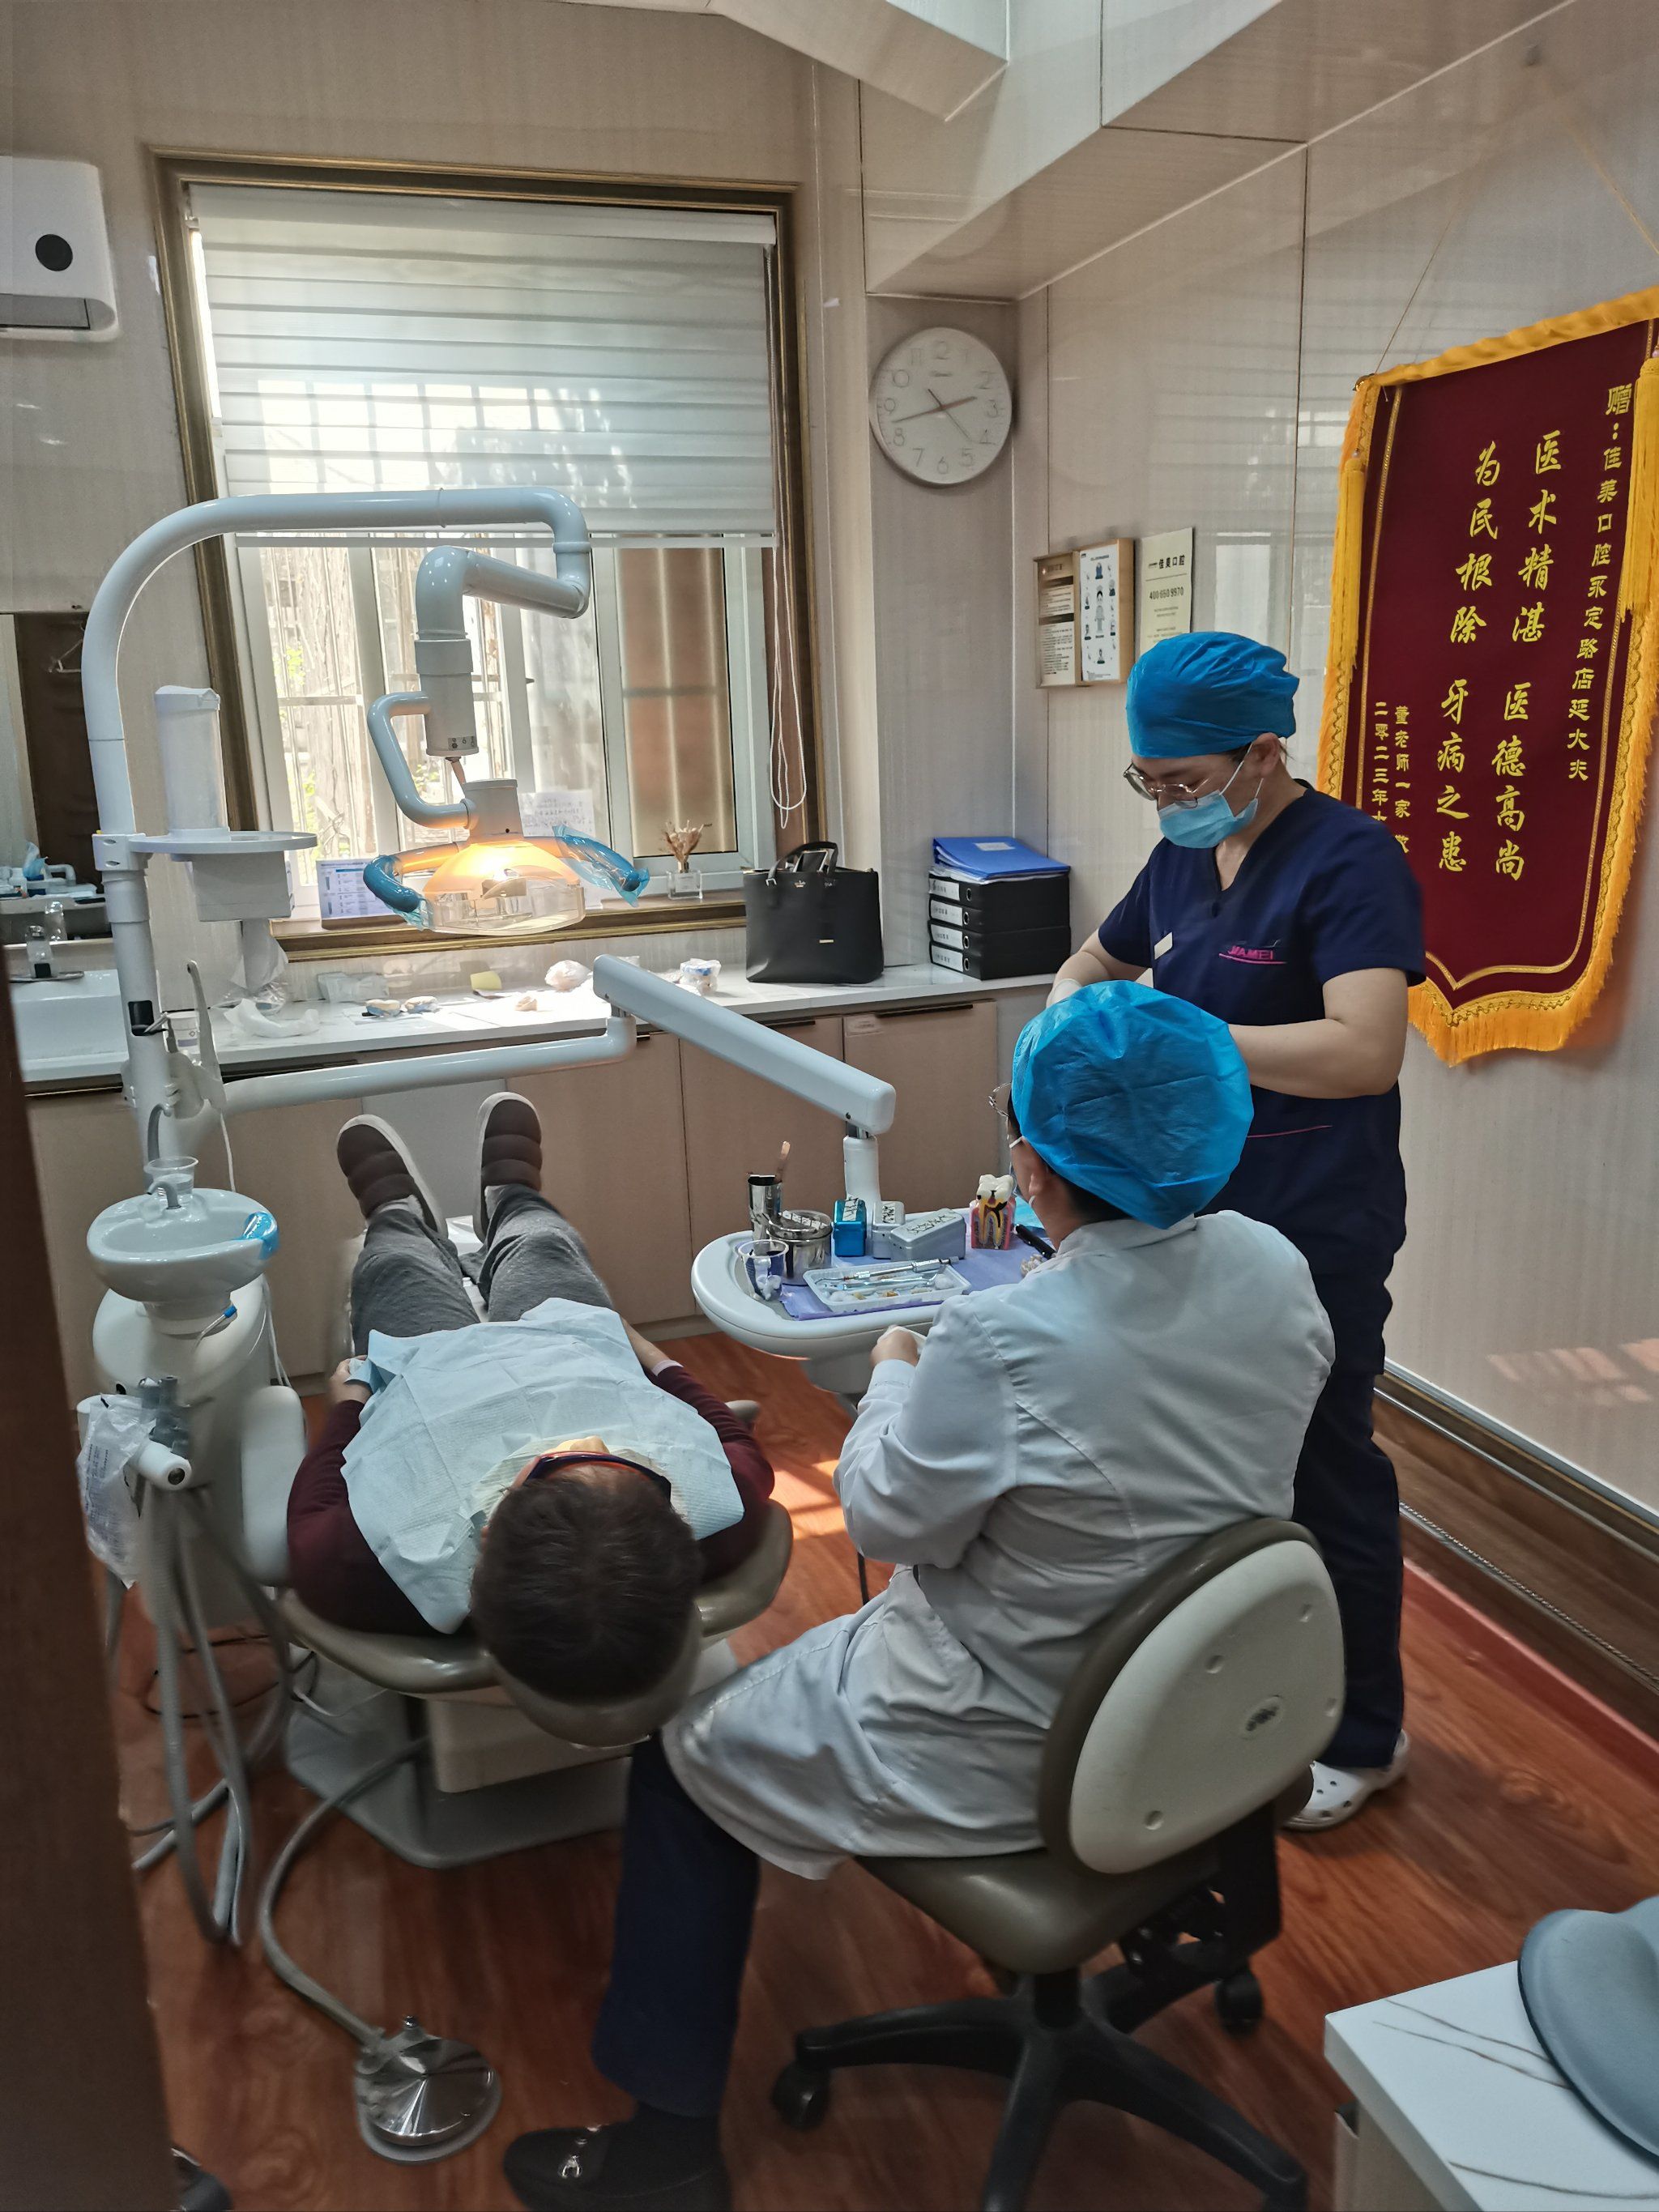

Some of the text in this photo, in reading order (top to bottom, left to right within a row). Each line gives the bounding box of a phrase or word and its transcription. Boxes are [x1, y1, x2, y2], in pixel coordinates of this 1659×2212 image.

[884, 398, 896, 416] 9
[986, 399, 999, 419] 3
[893, 428, 906, 447] 8
[979, 428, 996, 445] 4
[912, 447, 926, 467] 7
[936, 455, 949, 475] 6
[959, 447, 975, 467] 5
